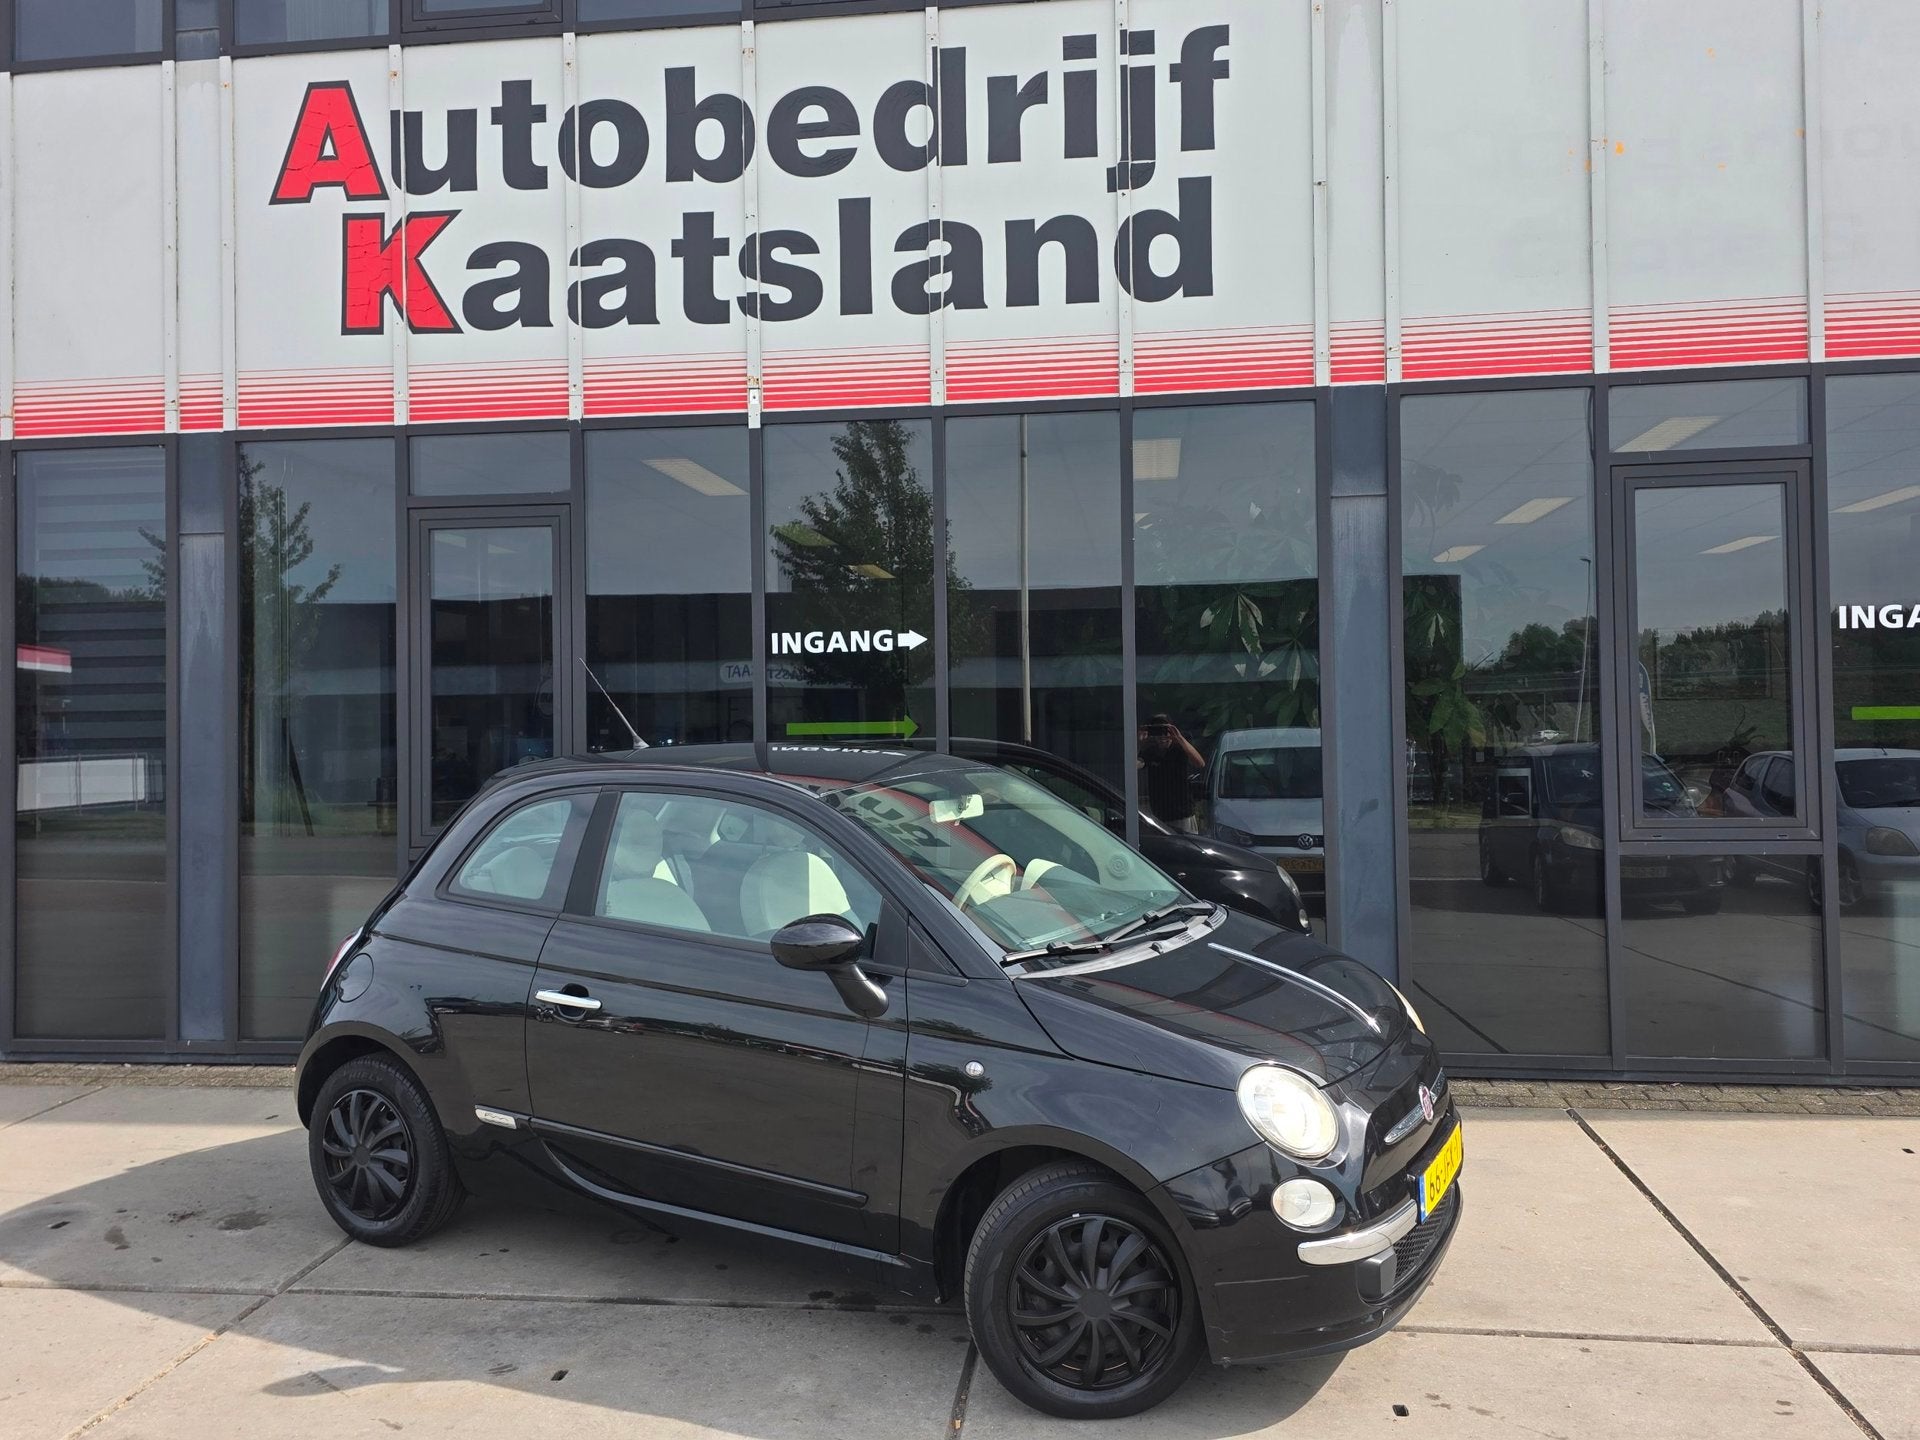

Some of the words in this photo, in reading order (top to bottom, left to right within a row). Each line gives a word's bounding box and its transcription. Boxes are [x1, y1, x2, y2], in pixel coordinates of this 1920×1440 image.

[268, 24, 1230, 206] Autobedrijf
[341, 176, 1214, 336] Kaatsland
[771, 629, 893, 654] INGANG
